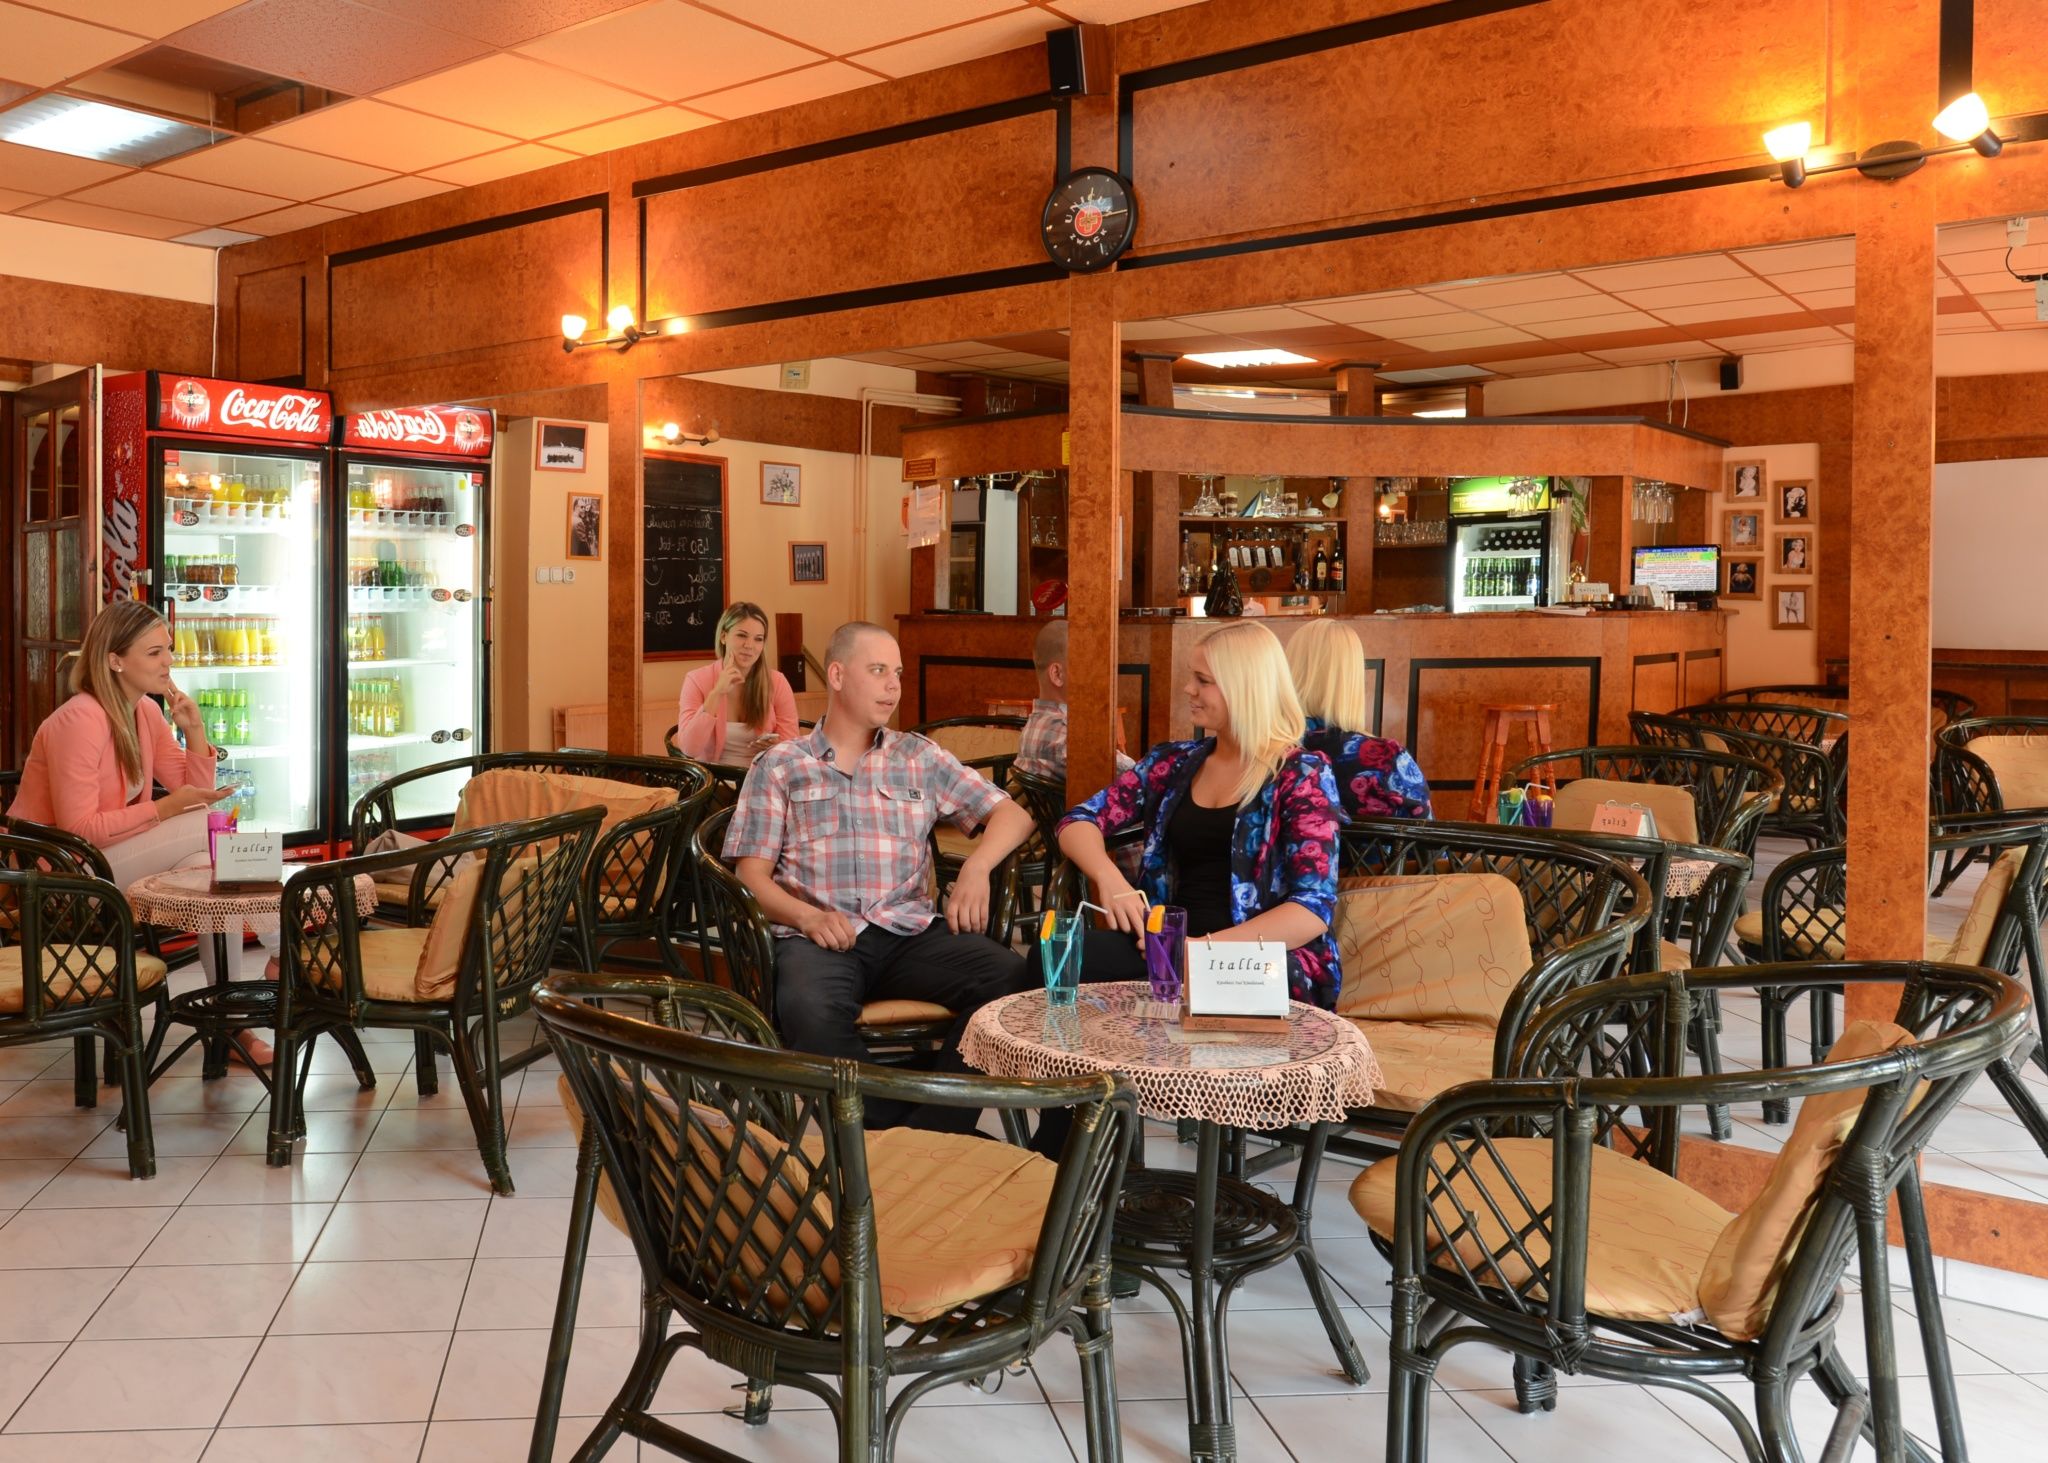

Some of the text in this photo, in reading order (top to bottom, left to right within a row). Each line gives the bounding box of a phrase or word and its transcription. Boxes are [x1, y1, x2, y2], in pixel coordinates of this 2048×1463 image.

[1069, 228, 1108, 246] ZWACK
[220, 388, 322, 433] Coca-Cola
[1208, 958, 1272, 975] Itallap
